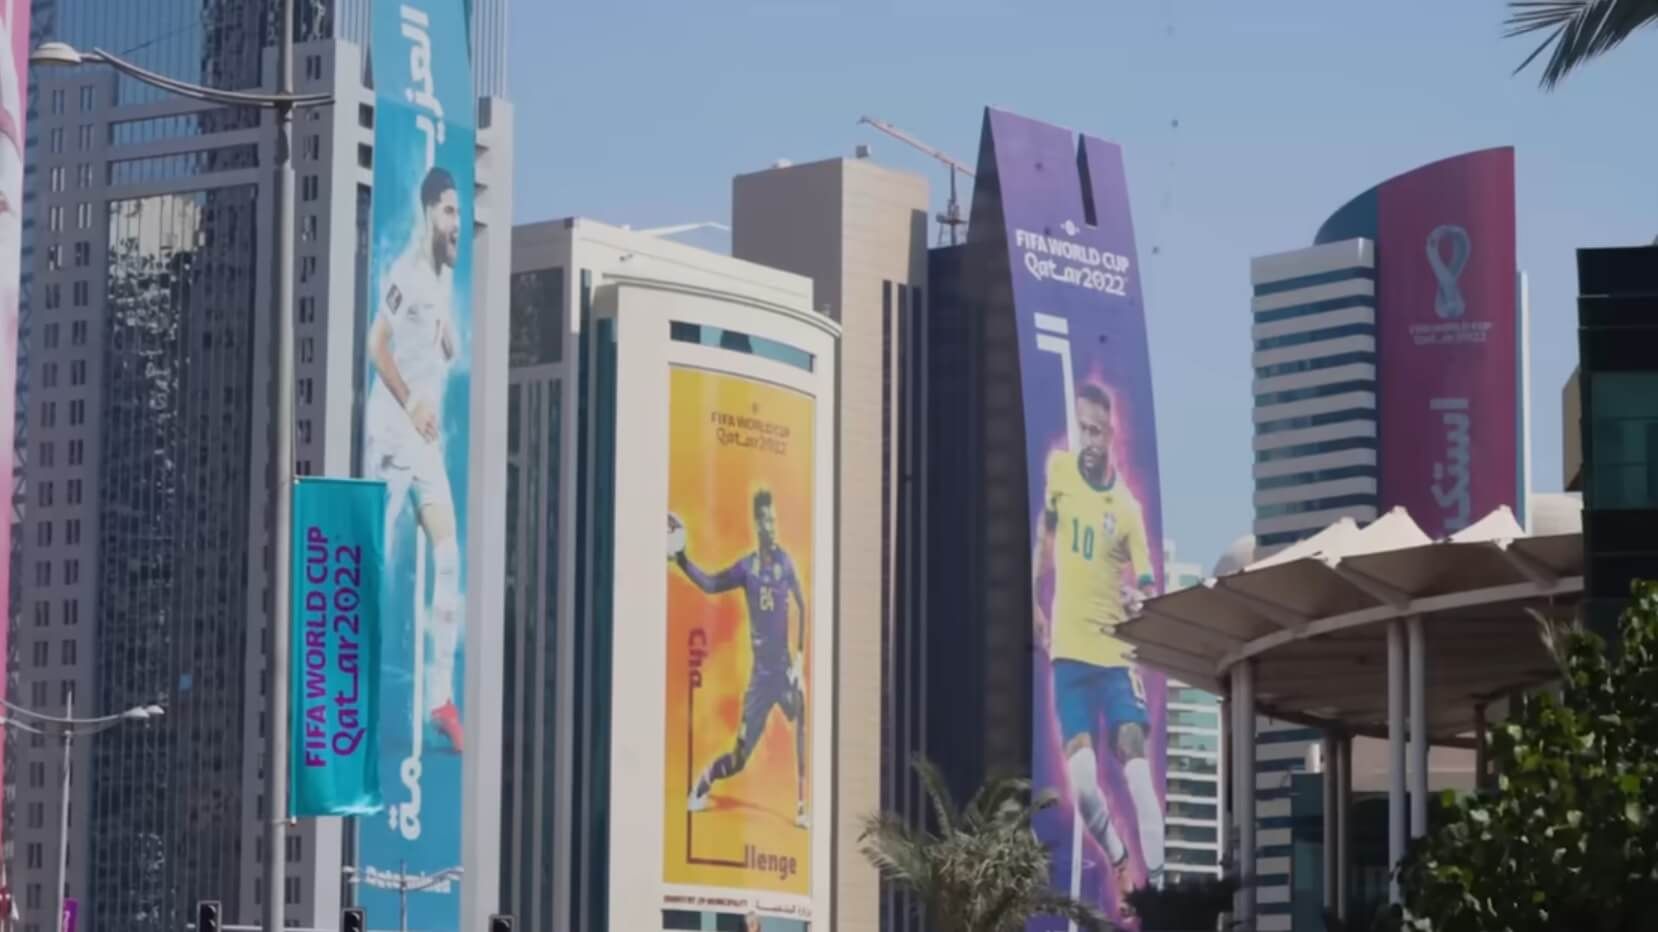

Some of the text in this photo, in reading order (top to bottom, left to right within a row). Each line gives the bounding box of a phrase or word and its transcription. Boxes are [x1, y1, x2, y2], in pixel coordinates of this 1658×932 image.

[1016, 228, 1130, 273] FIFA WORLD CUP
[1072, 517, 1094, 560] 10
[304, 525, 329, 767] FIFA WORLD CUP
